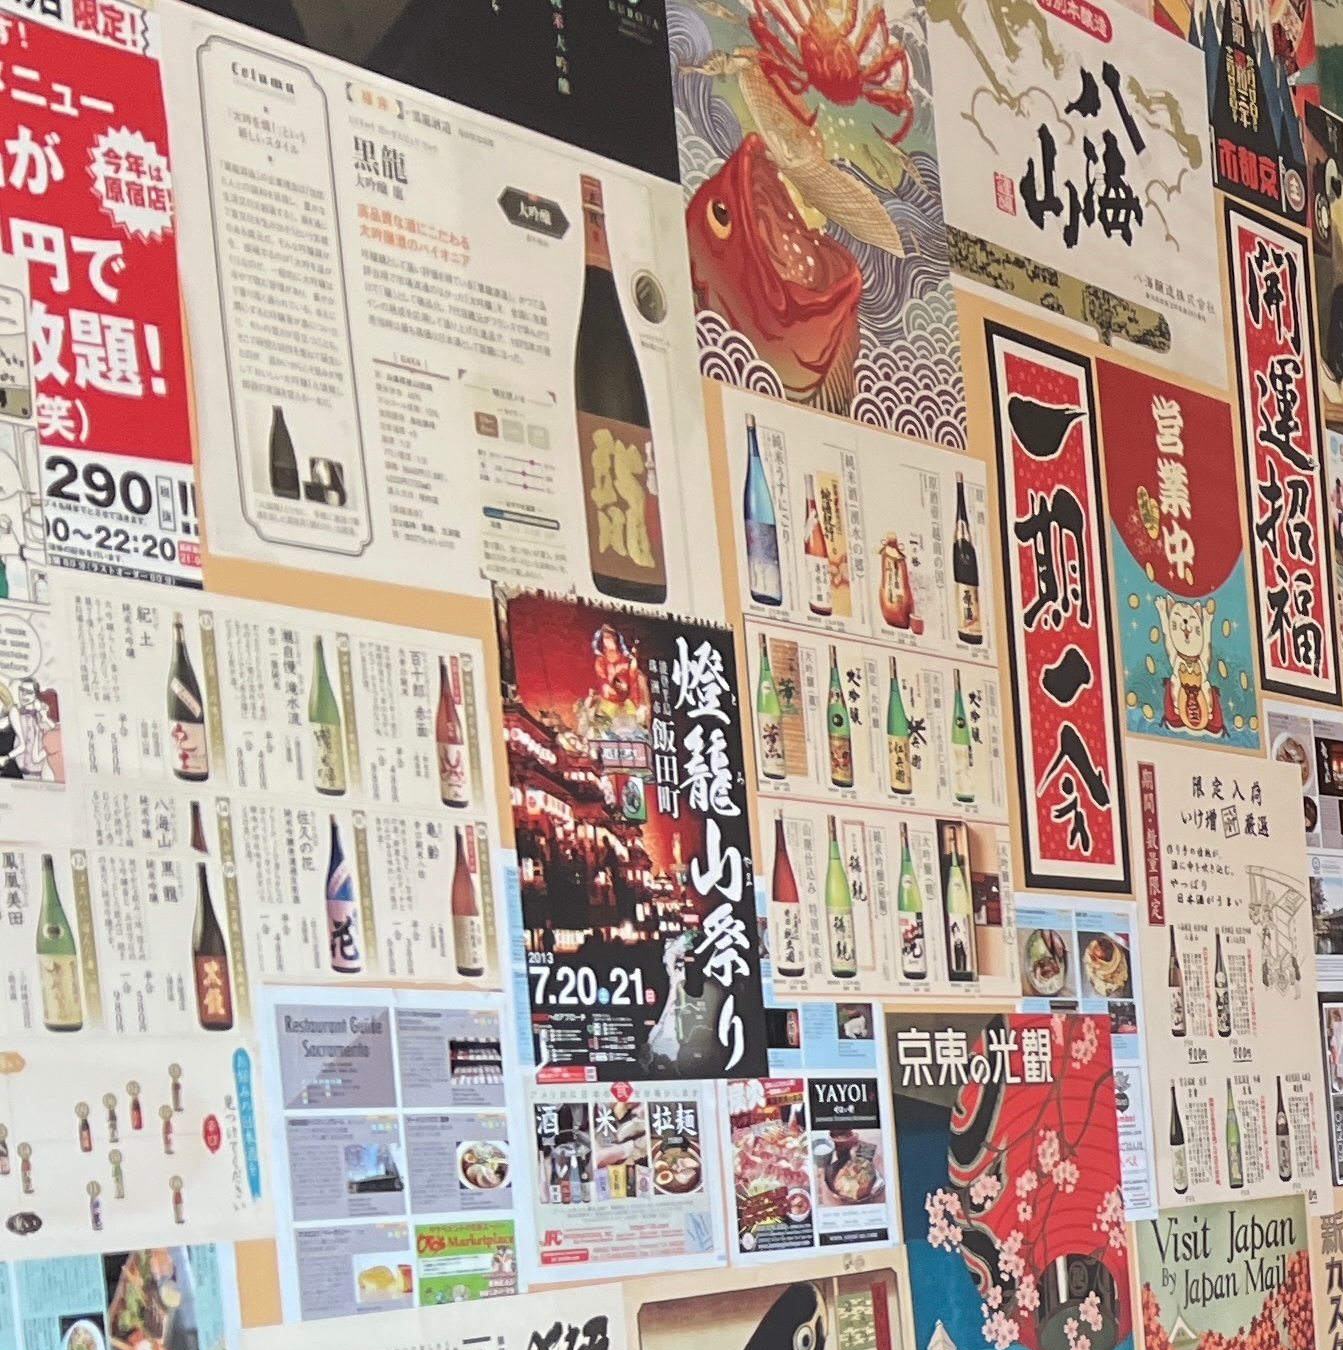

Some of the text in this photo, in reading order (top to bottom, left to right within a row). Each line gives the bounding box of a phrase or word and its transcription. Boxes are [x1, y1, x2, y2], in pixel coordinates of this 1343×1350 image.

[71, 0, 139, 47] 限定!
[231, 62, 295, 94] Column
[103, 148, 162, 182] 今年は
[354, 136, 408, 185] 黒龍
[105, 177, 174, 213] 原宿店!
[1247, 241, 1317, 676] 開運招福
[1152, 395, 1194, 579] 営業中
[1008, 395, 1110, 853] 一期一会
[651, 716, 680, 820] 飯田町
[671, 635, 752, 1072] 燈籠山祭り
[3, 851, 24, 926] 鳳凰美田
[528, 951, 555, 964] 2013
[528, 965, 599, 1006] 7.20
[609, 967, 645, 1006] 21
[284, 1014, 384, 1035] Restaurant Guide
[301, 1038, 371, 1060] Sacramento
[814, 1083, 869, 1103] YAYOI
[536, 1104, 560, 1137] 酒
[595, 1107, 619, 1138] 米
[651, 1105, 698, 1137] 拉麺
[1151, 1208, 1297, 1264] Visit Japan
[1161, 1252, 1287, 1310] By Japan Mail
